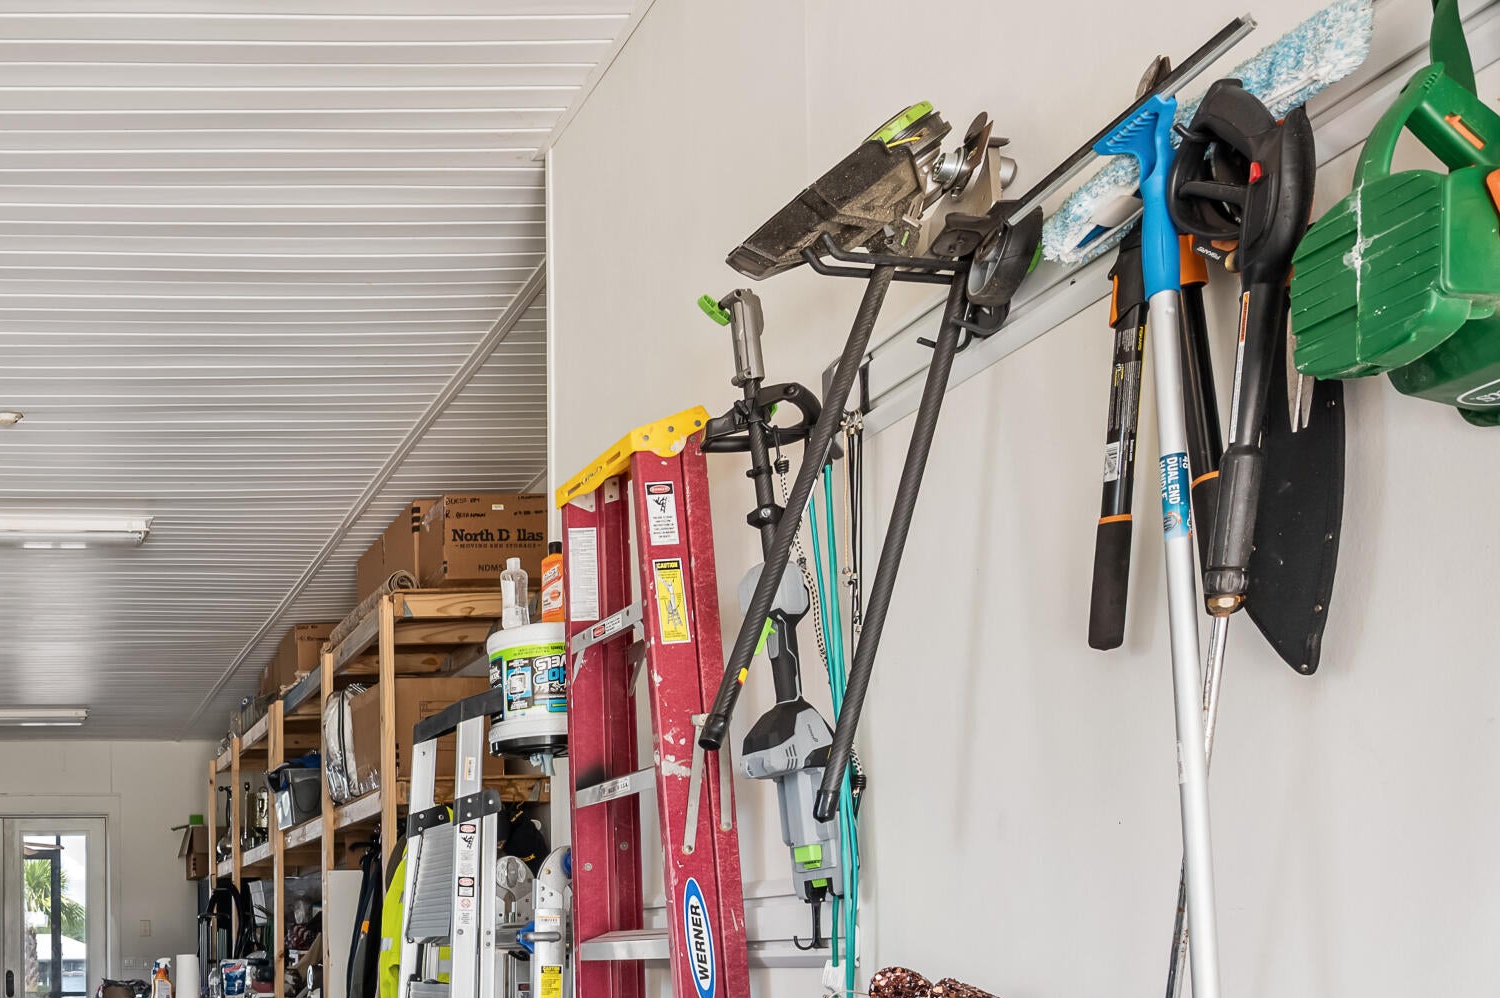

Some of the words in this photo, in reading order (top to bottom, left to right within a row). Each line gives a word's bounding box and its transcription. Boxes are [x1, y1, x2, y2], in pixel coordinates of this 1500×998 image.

[1167, 456, 1179, 484] DUAL
[1168, 484, 1181, 505] END
[451, 529, 495, 542] North
[690, 904, 710, 981] WERNER
